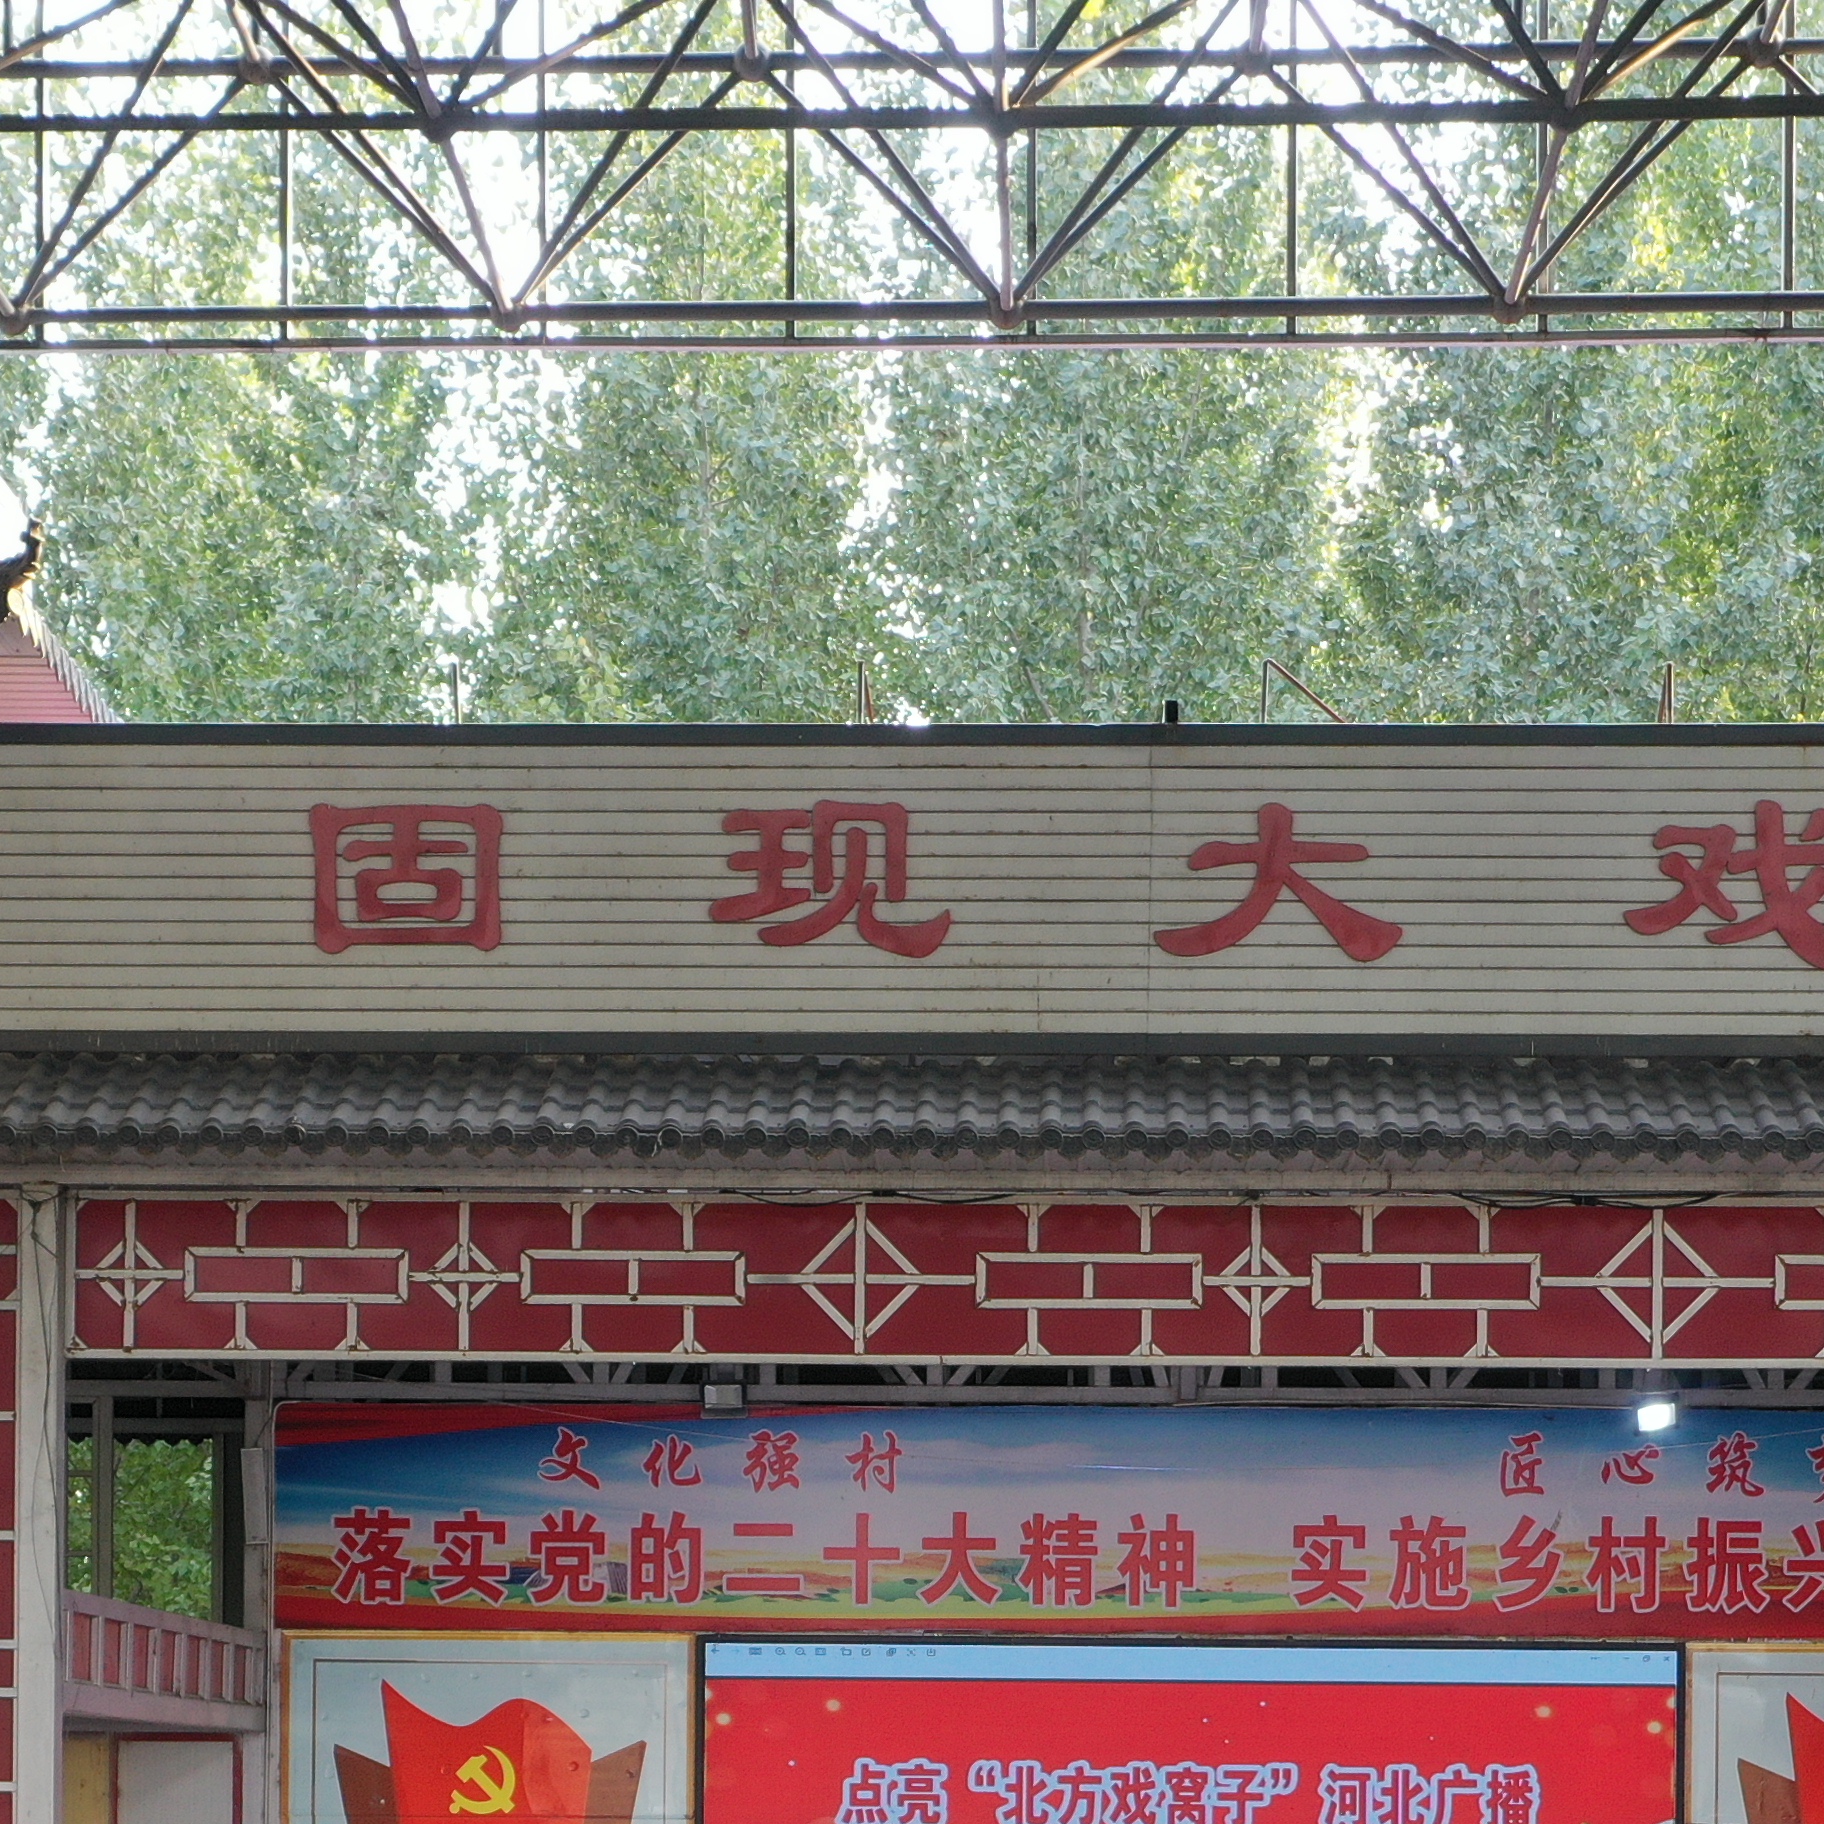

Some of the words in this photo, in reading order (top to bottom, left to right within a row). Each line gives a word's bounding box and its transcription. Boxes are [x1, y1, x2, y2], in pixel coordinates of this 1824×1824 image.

[537, 1426, 902, 1494] 文化强村
[330, 1508, 1197, 1609] 落实党的二十大精神
